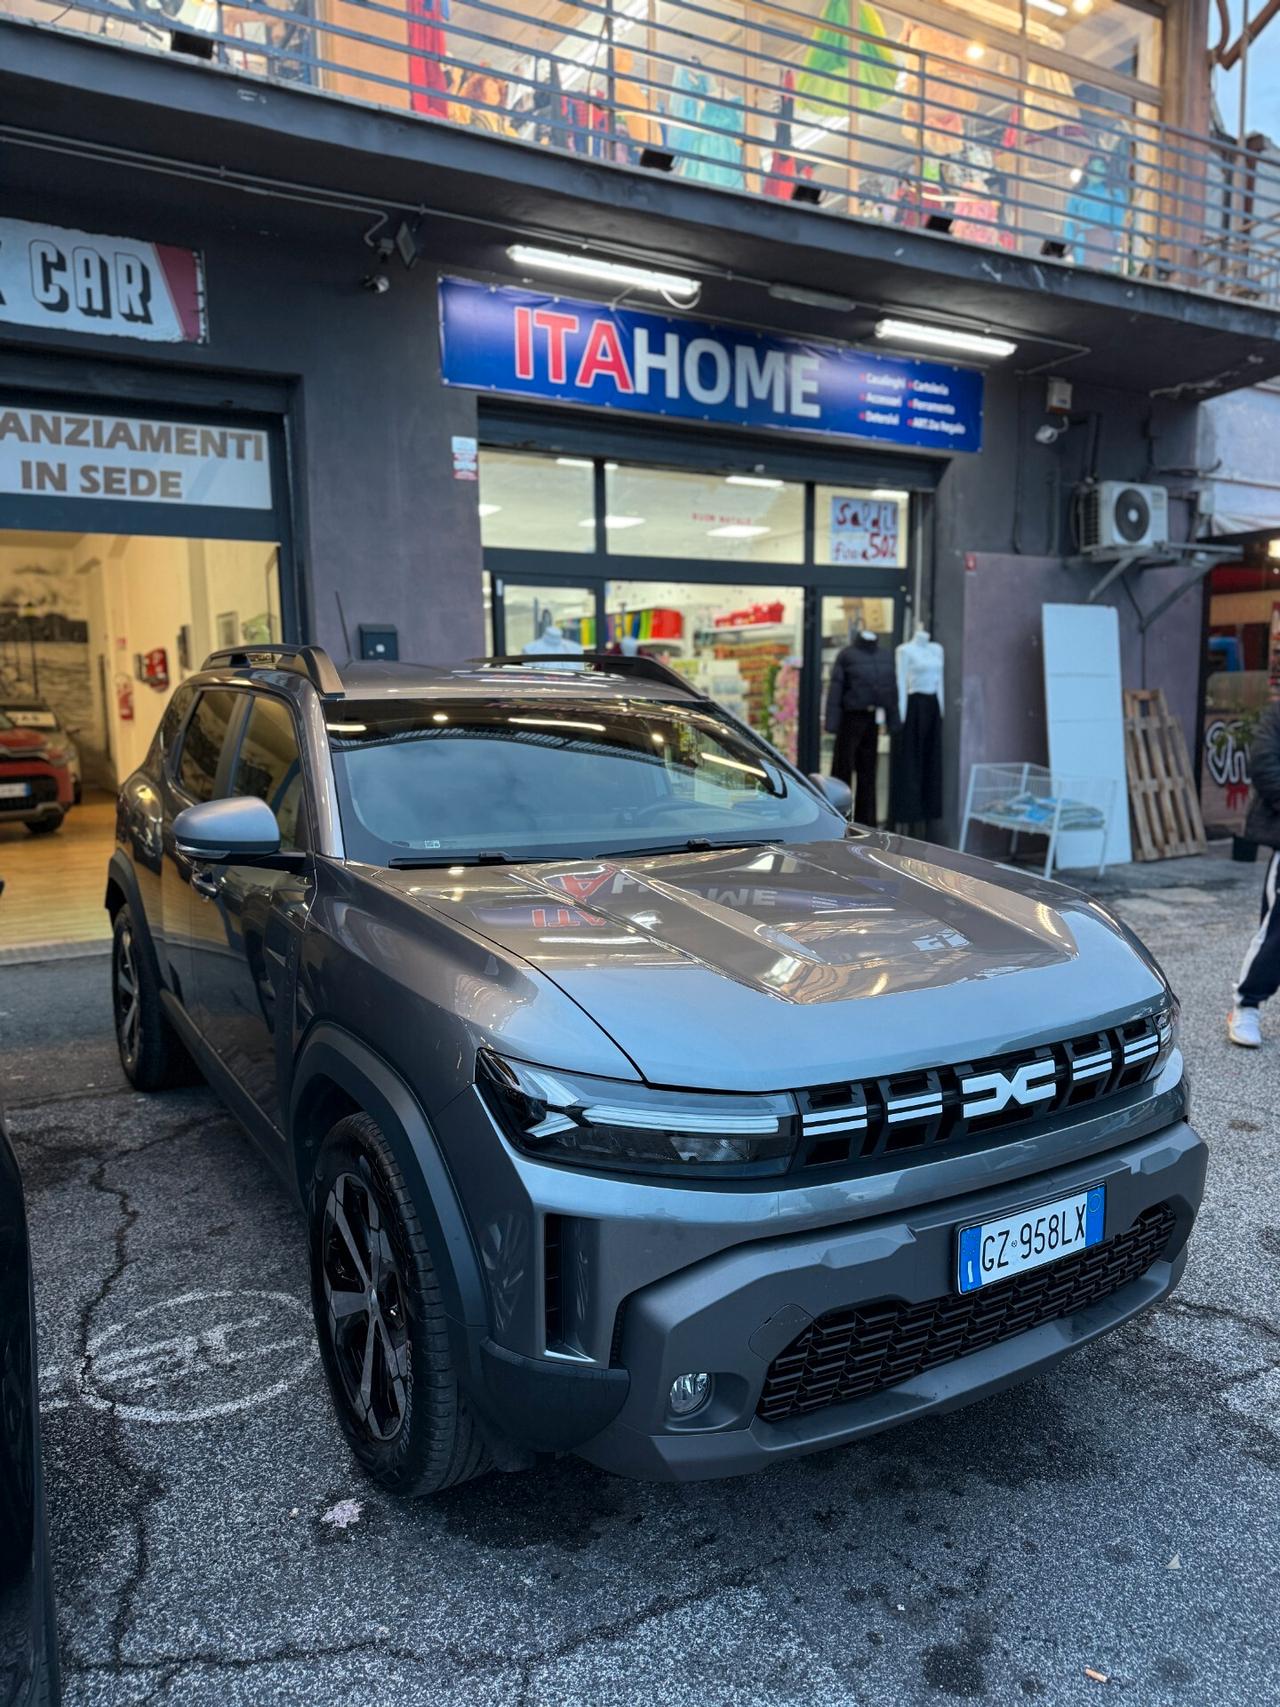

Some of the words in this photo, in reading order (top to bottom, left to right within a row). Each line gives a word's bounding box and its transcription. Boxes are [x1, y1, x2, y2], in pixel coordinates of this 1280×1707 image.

[29, 239, 153, 325] CAR
[513, 306, 821, 419] ITAHOME
[20, 461, 67, 492] IN
[80, 465, 183, 499] SEDE
[981, 1229, 1010, 1272] GZ
[1020, 1203, 1086, 1260] 958LX
